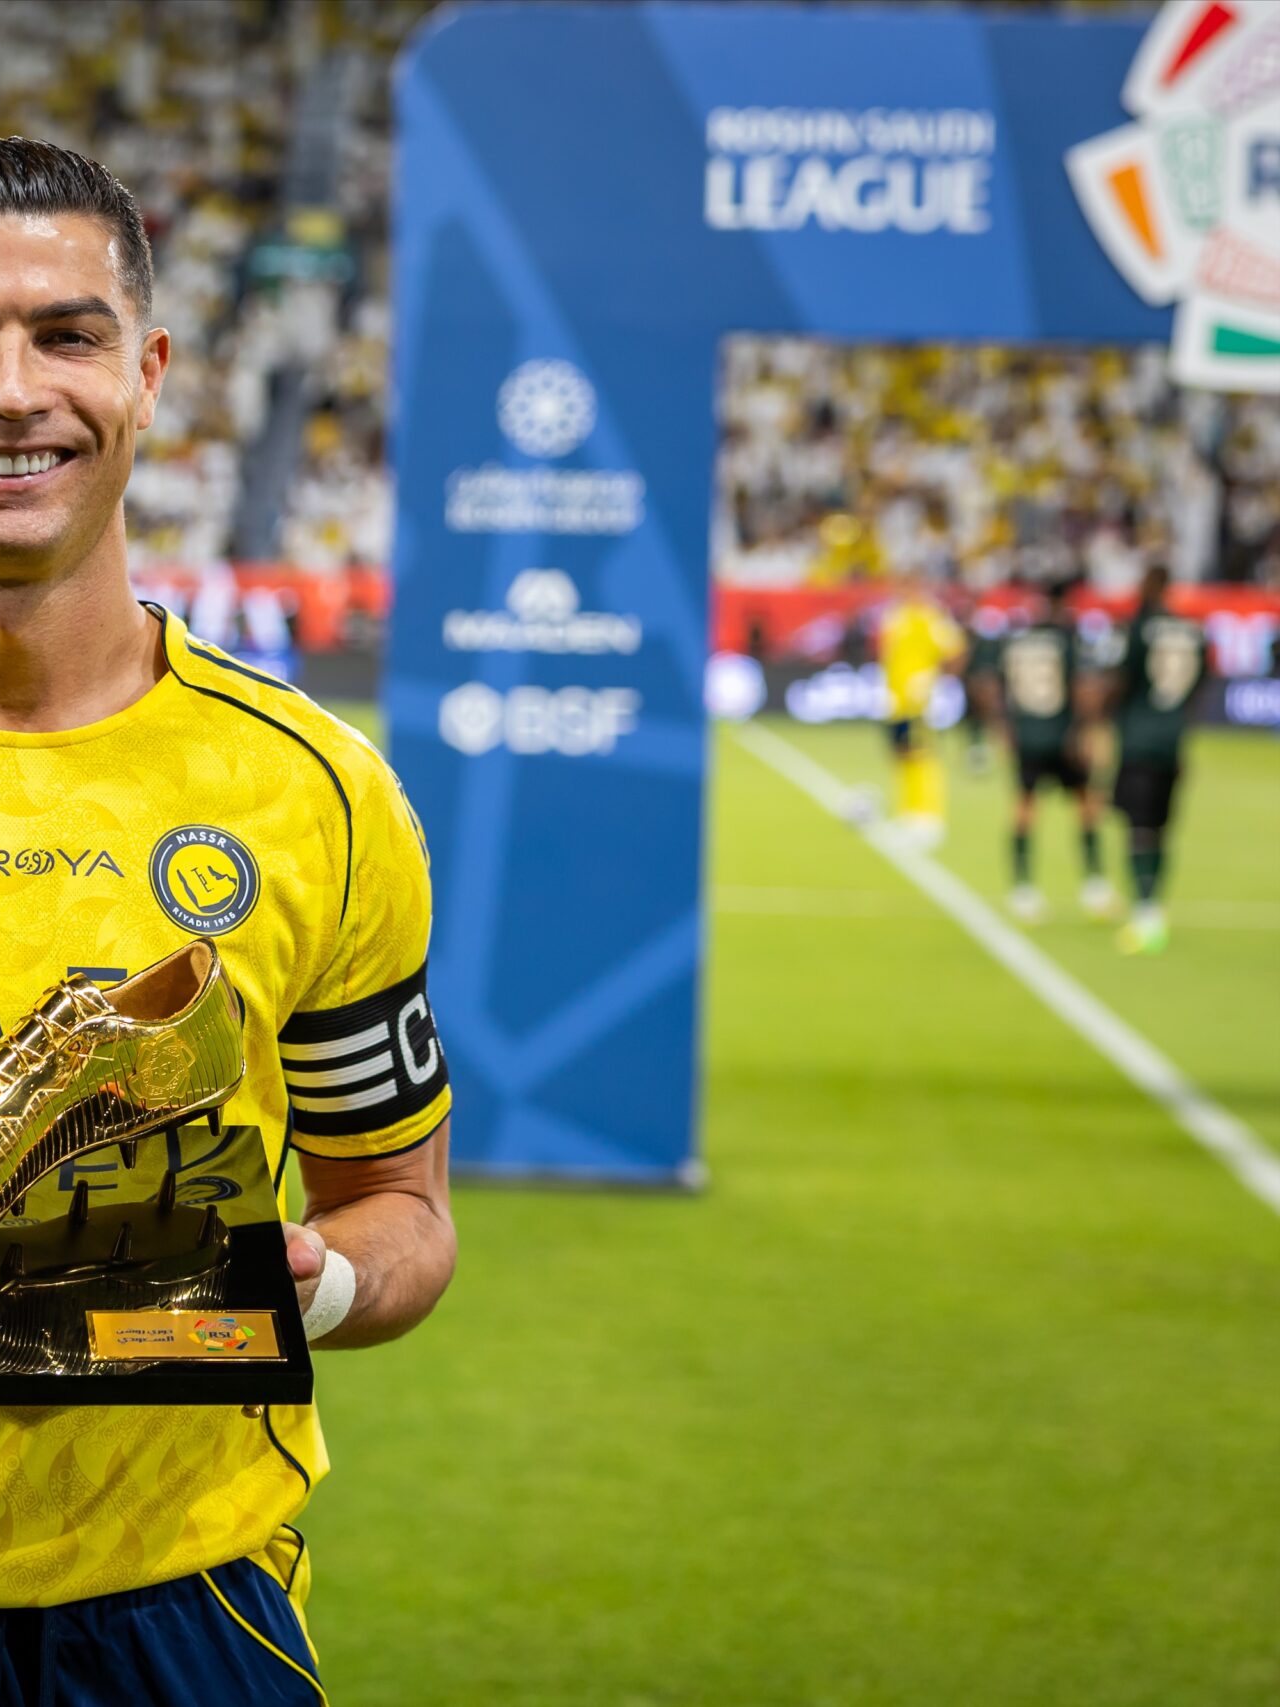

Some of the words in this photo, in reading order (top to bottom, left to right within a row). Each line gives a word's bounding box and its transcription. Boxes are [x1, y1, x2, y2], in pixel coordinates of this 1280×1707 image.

[705, 155, 991, 234] LEAGUE
[175, 831, 227, 848] NASSR
[172, 907, 210, 928] RIYADH
[214, 911, 236, 928] 1955
[398, 992, 439, 1085] C
[208, 1330, 233, 1339] RSL
